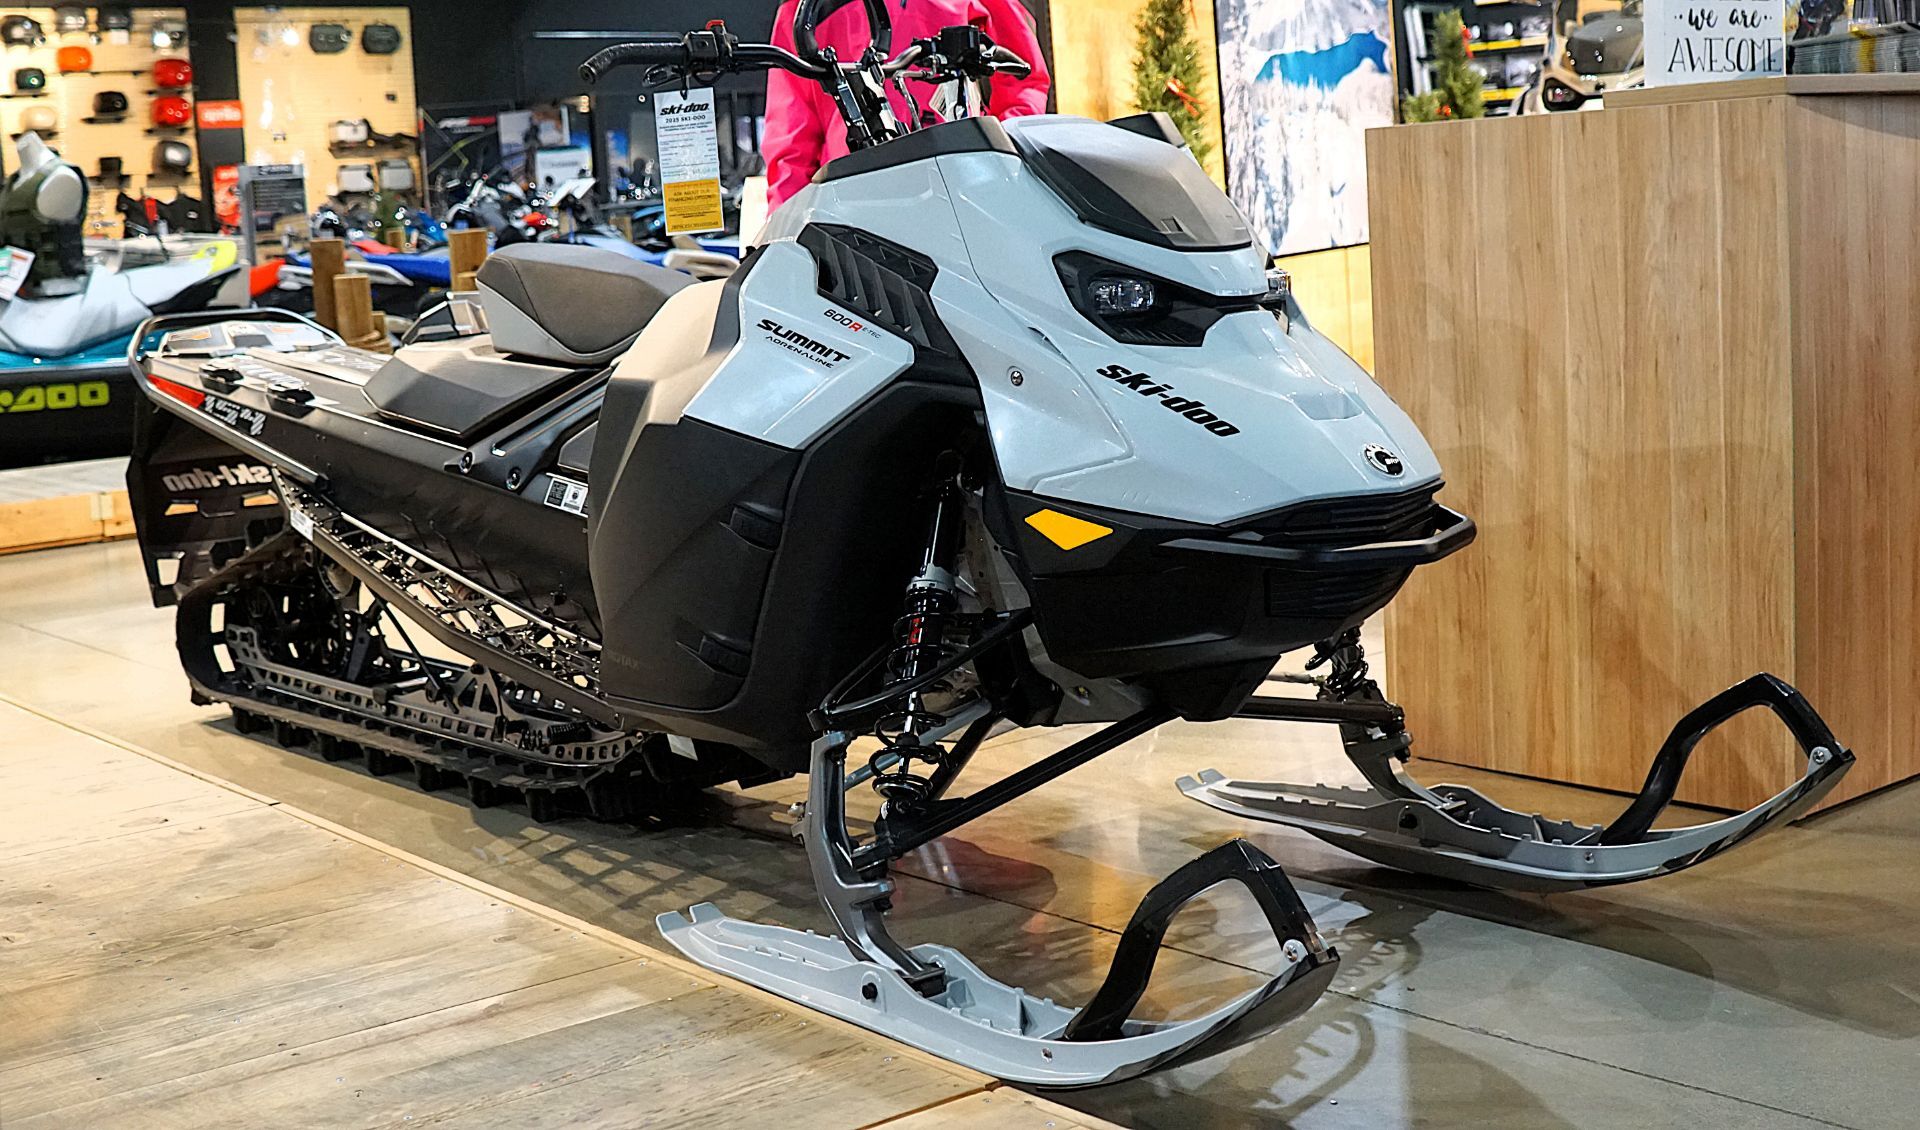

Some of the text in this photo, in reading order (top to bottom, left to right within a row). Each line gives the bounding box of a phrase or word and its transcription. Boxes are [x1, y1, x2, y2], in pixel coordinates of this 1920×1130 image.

[1688, 8, 1763, 30] we are
[1668, 36, 1783, 73] AWESOME
[660, 102, 709, 116] ski-doo
[757, 319, 850, 363] SUMMIT
[766, 336, 834, 369] ADRENALINE
[1096, 364, 1240, 437] ski-doo
